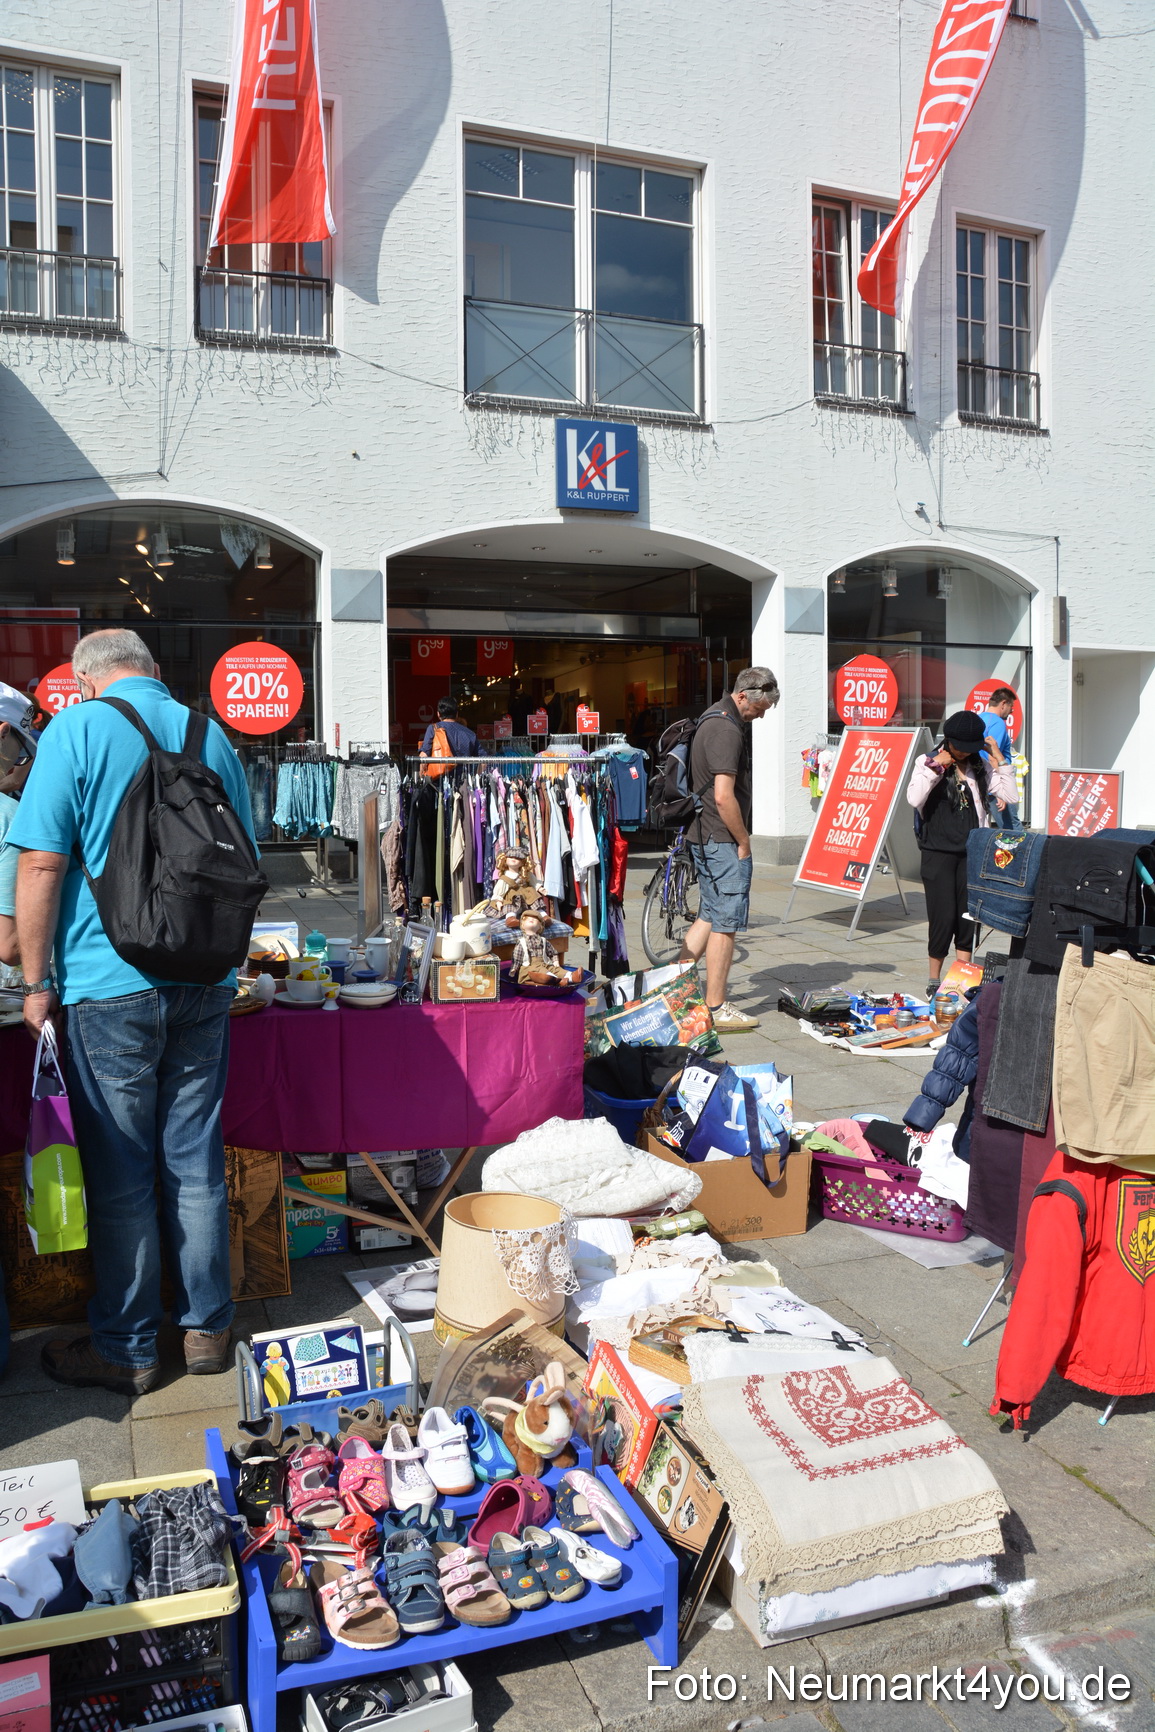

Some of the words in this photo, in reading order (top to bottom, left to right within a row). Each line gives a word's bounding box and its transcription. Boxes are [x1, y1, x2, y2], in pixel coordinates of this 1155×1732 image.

[565, 428, 630, 493] K&L
[566, 491, 585, 499] K&L
[587, 491, 630, 502] RUPPERT
[226, 672, 289, 700] 20%
[843, 679, 888, 704] 20%
[226, 703, 289, 718] SPAREN!
[849, 747, 891, 775] 20%
[1054, 774, 1085, 824] REDUZIERT
[1065, 774, 1108, 836] DUZIERT
[832, 801, 872, 831] 30%
[1092, 806, 1114, 834] ZIERT
[846, 864, 866, 879] K&L
[620, 1019, 633, 1032] Wir
[306, 1174, 343, 1186] JUMBO
[286, 1206, 323, 1226] mpers
